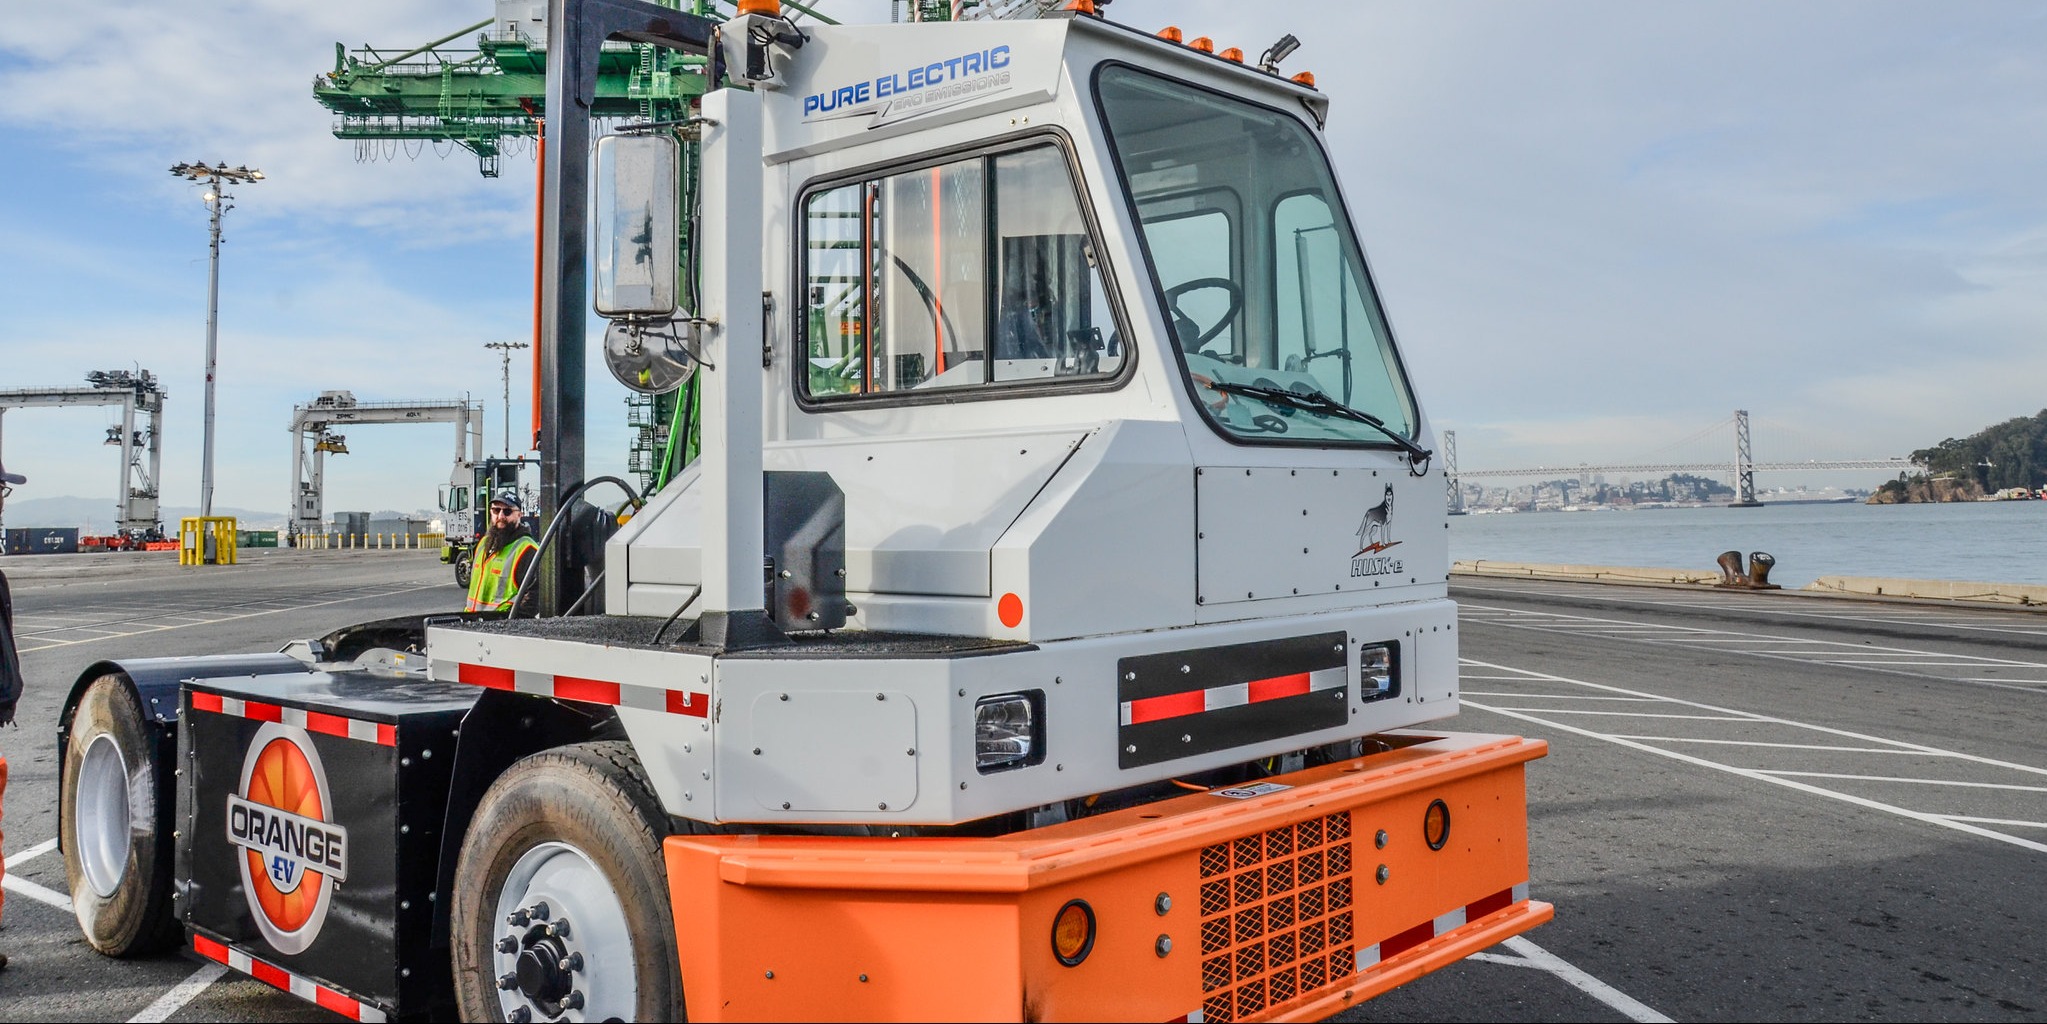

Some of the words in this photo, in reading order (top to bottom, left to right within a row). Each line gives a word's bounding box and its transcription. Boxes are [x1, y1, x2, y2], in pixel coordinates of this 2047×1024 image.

[804, 82, 870, 116] PURE
[877, 45, 1010, 97] ELECTRIC
[924, 72, 1011, 103] EMISSIONS
[232, 804, 342, 870] ORANGE
[272, 855, 296, 884] EV
